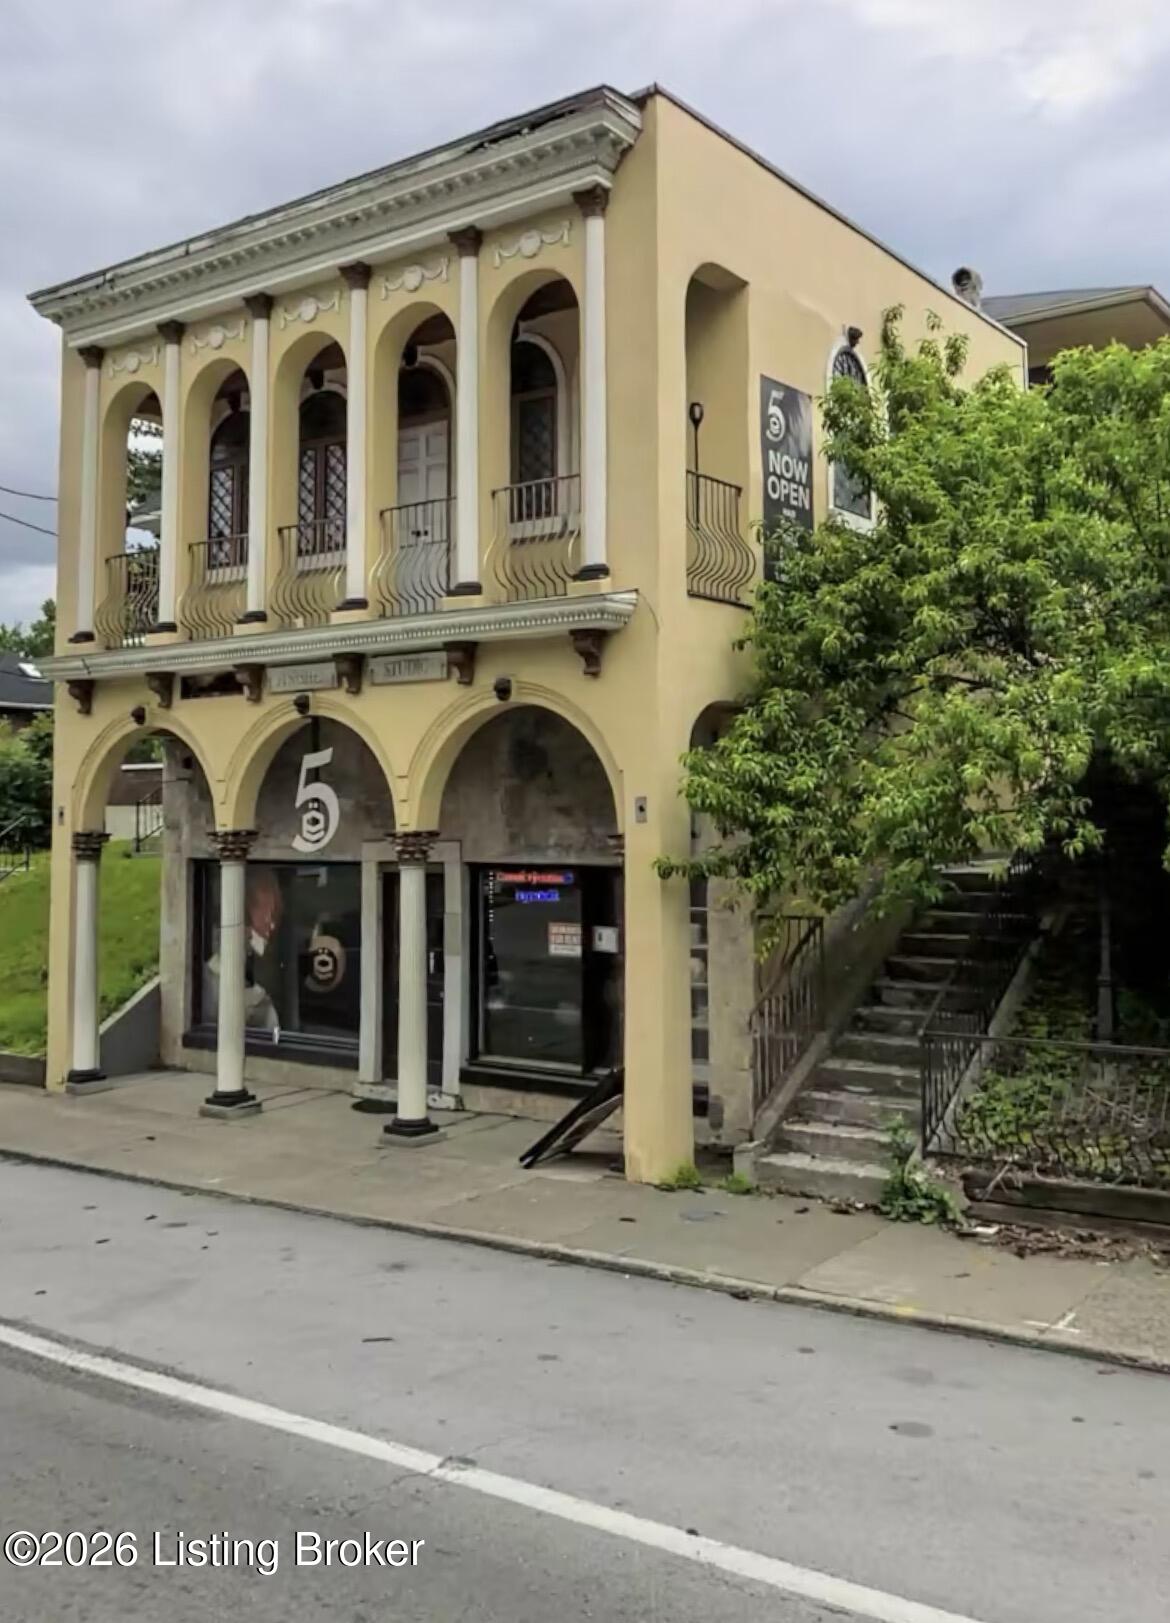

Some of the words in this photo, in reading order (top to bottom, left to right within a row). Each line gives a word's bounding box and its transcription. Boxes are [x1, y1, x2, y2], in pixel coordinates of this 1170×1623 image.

[768, 449, 809, 484] NOW
[767, 477, 811, 511] OPEN
[291, 746, 340, 853] 5
